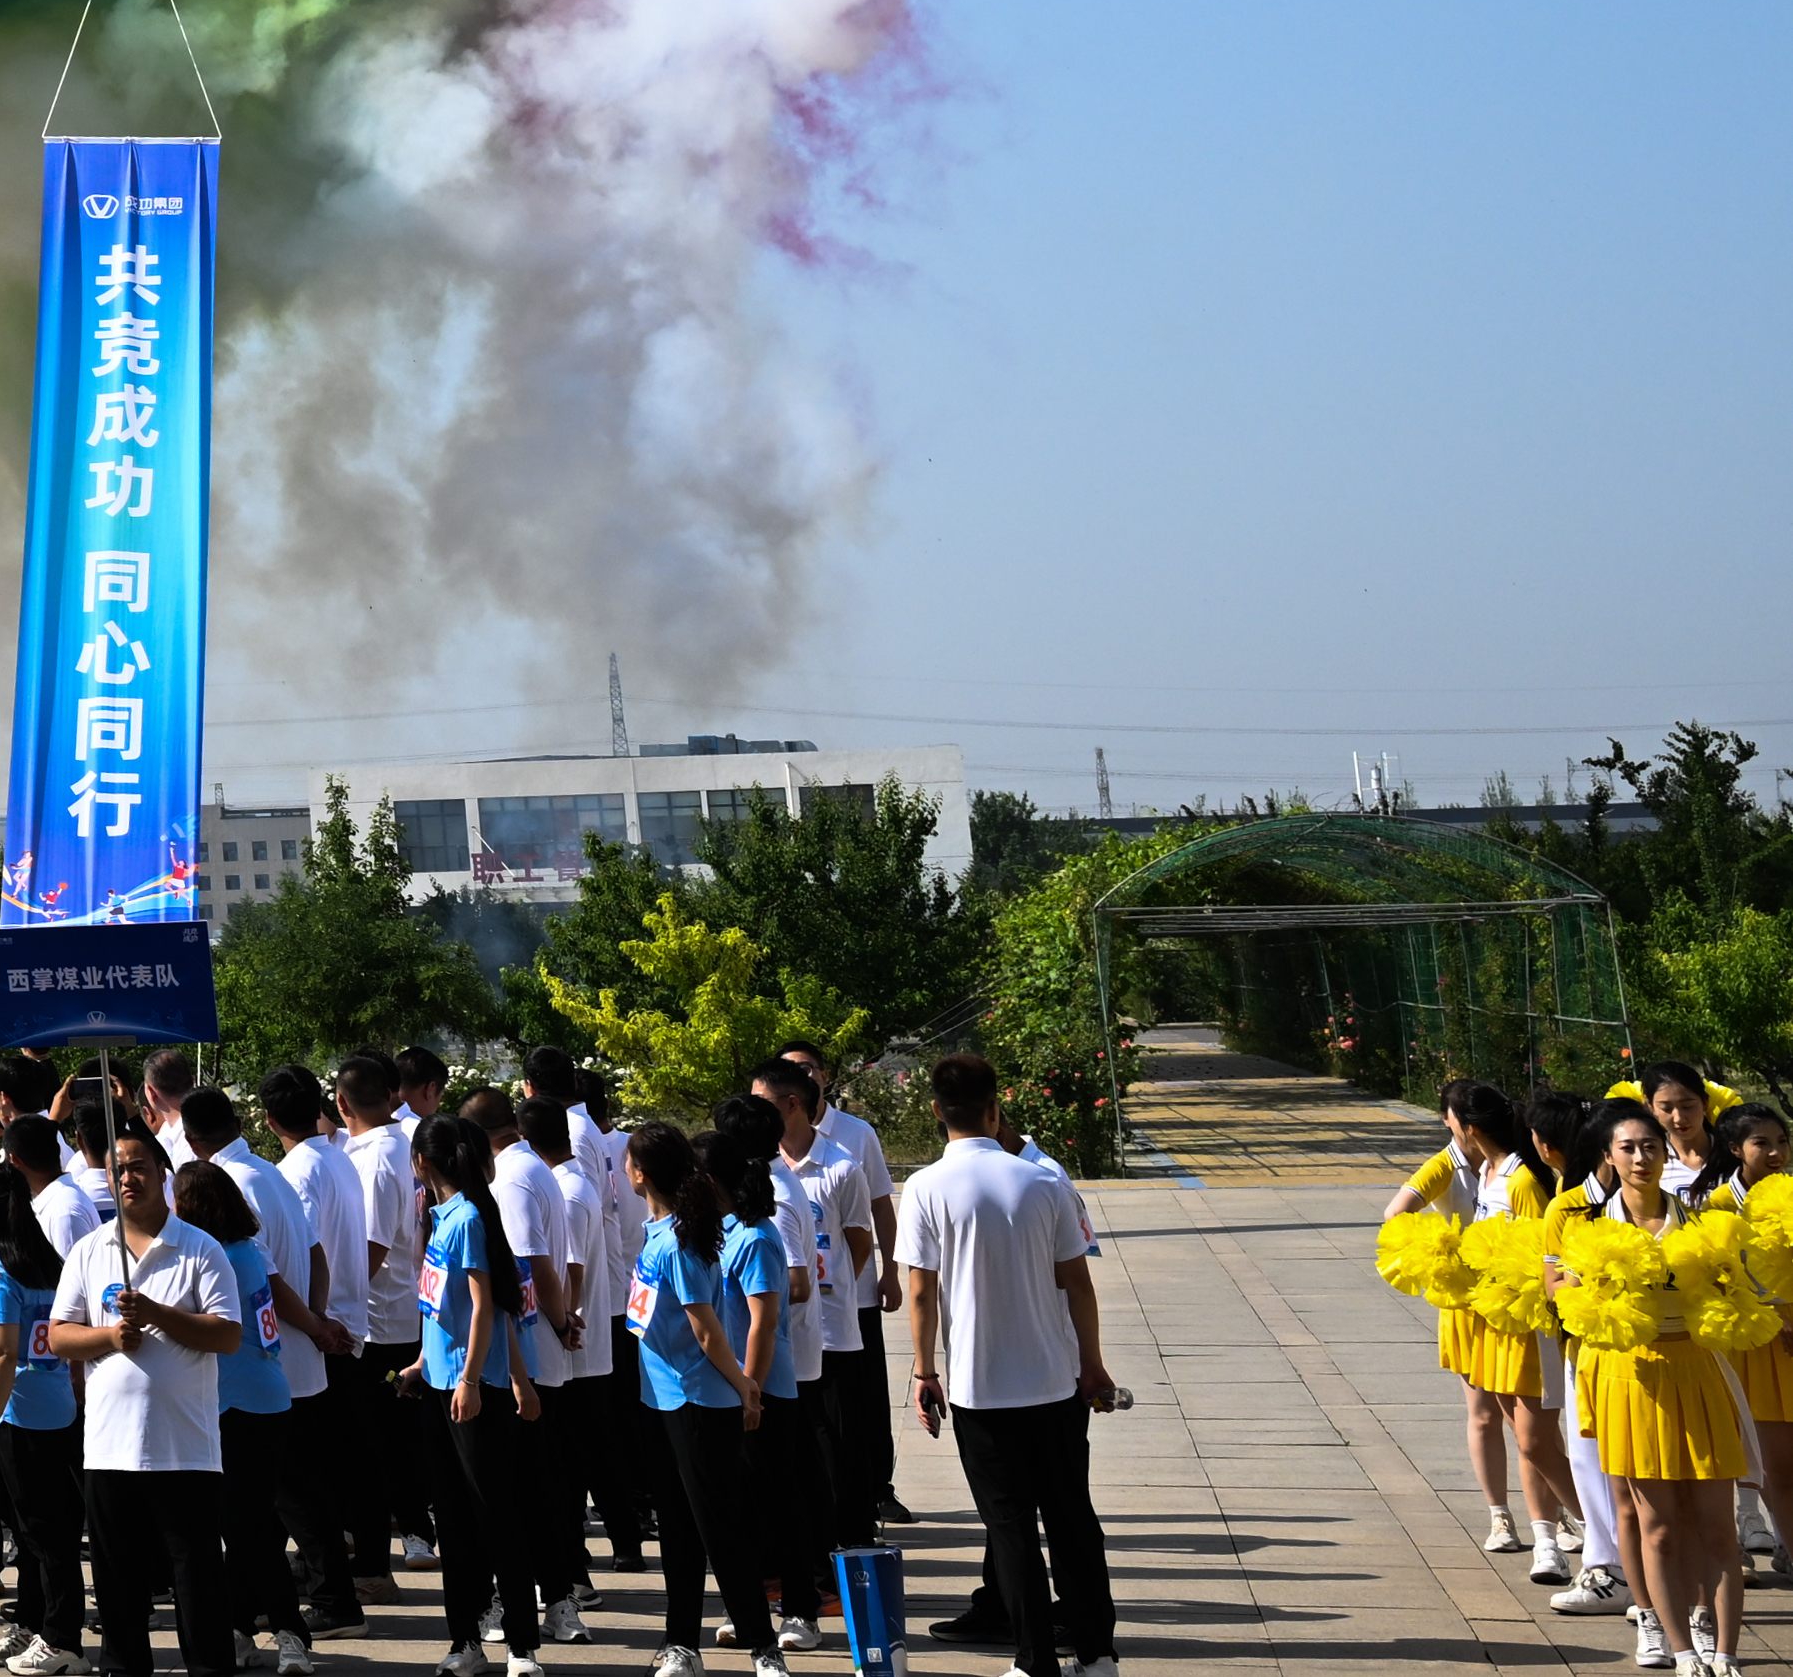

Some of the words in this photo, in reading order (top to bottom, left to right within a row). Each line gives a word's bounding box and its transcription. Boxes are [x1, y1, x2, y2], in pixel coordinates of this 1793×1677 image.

[85, 243, 162, 520] 共竞成功
[67, 549, 151, 839] 同心同行
[6, 963, 181, 993] 西掌煤业代表队
